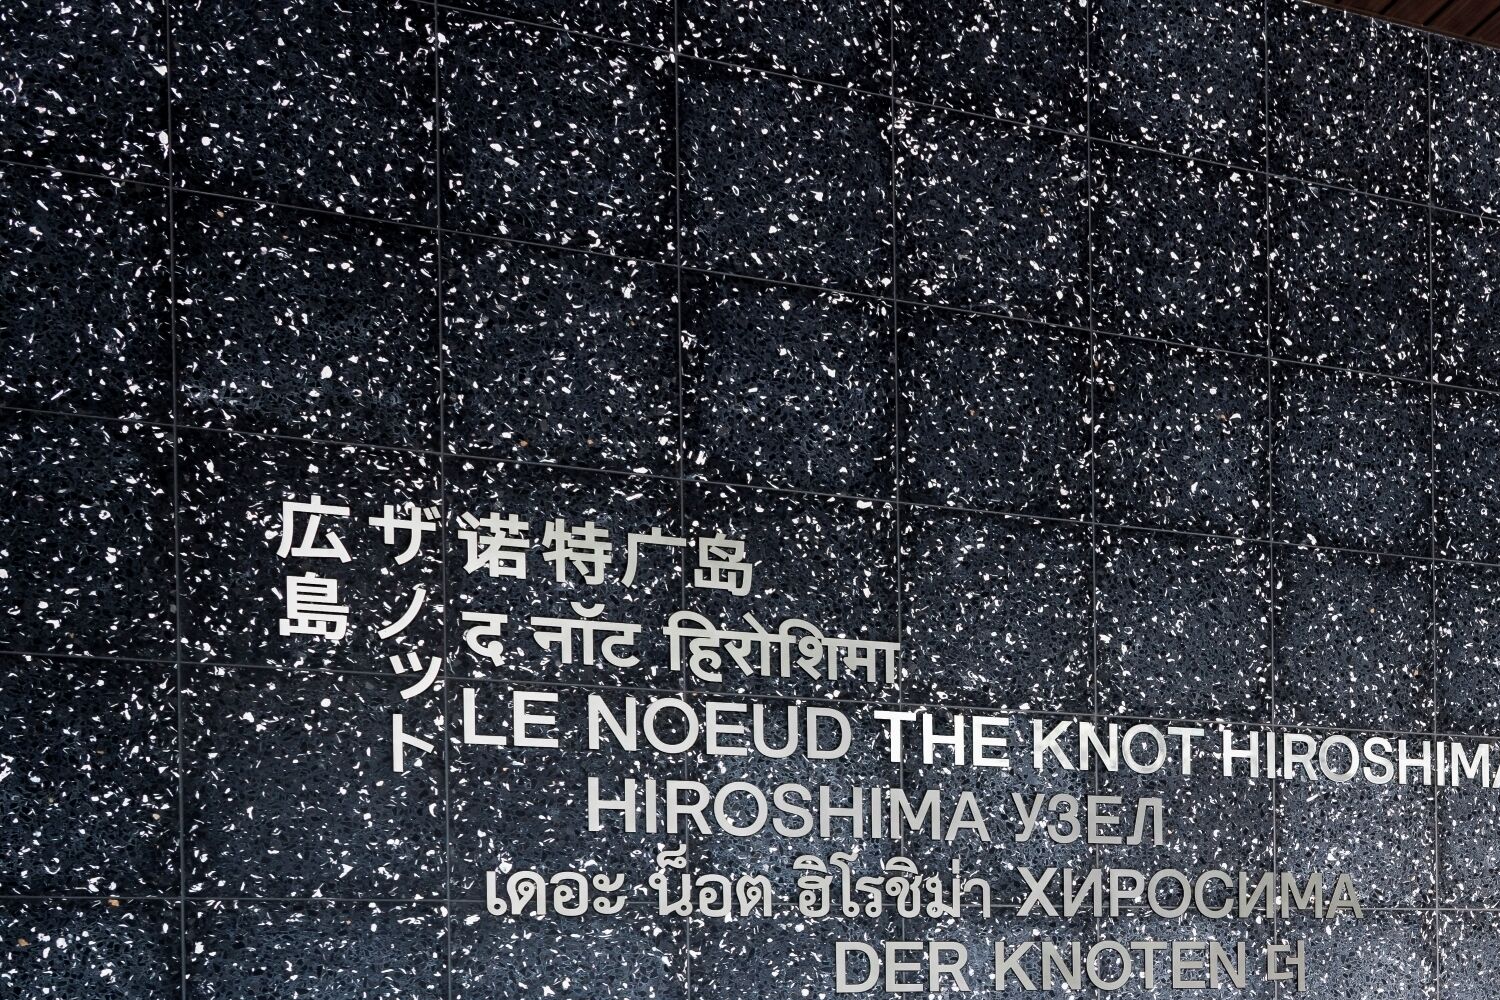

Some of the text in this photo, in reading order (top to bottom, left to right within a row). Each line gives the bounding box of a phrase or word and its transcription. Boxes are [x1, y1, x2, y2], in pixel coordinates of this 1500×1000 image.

[276, 494, 353, 641] 広島
[457, 510, 754, 597] 诺特广岛
[368, 503, 442, 773] ザノット
[461, 601, 901, 684] द नॉट हिरोशिमा
[461, 687, 853, 761] LE NOEUD
[872, 709, 1011, 768] THE
[1032, 719, 1205, 776] KNOT
[586, 775, 992, 842] HIROSHIMA
[1013, 791, 1166, 847] УЗЕЛ
[485, 844, 993, 920] เดอะ น็อต ฮิโรชิม่า
[1016, 865, 1365, 921] ХИРОСИМА
[834, 939, 1248, 995] DER KNOTEN
[1266, 939, 1306, 993] 더
